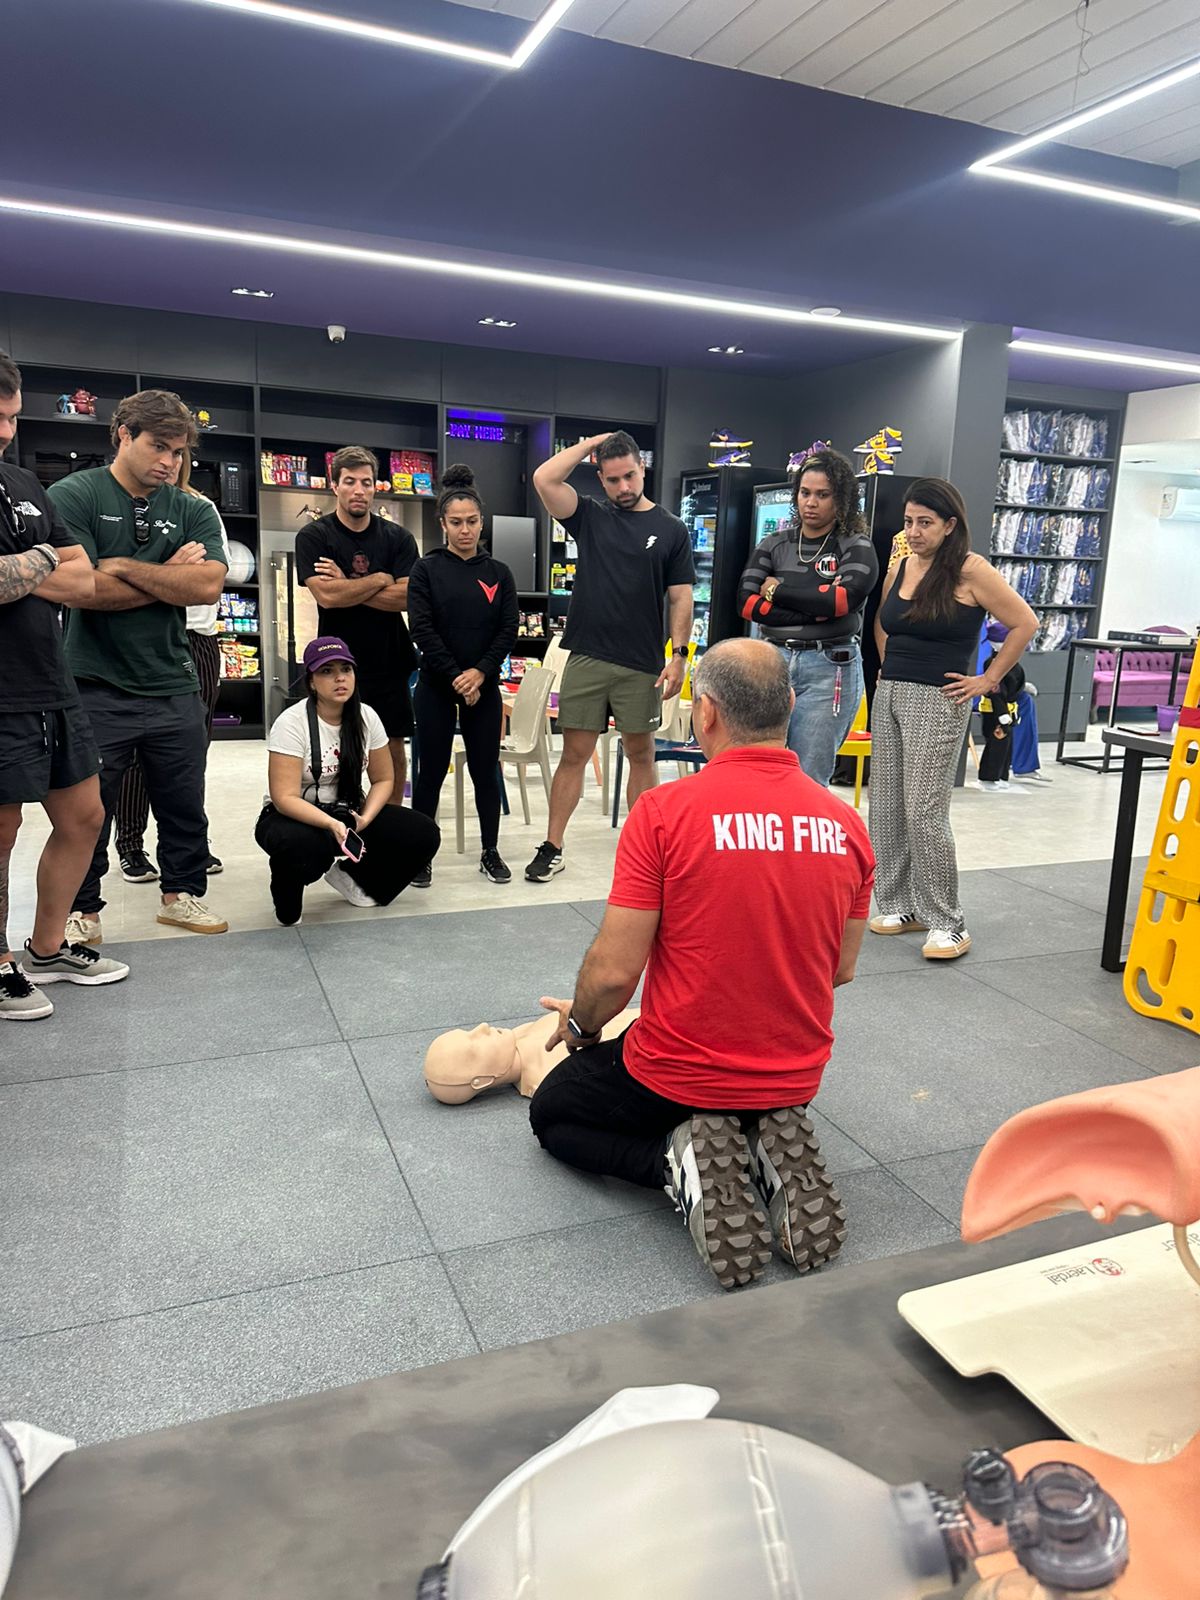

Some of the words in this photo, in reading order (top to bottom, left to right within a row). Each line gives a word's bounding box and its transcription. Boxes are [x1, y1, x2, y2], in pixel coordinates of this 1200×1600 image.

[474, 425, 504, 441] HERE
[712, 813, 784, 852] KING
[792, 815, 847, 856] FIRE
[1047, 1265, 1096, 1286] Laerdal
